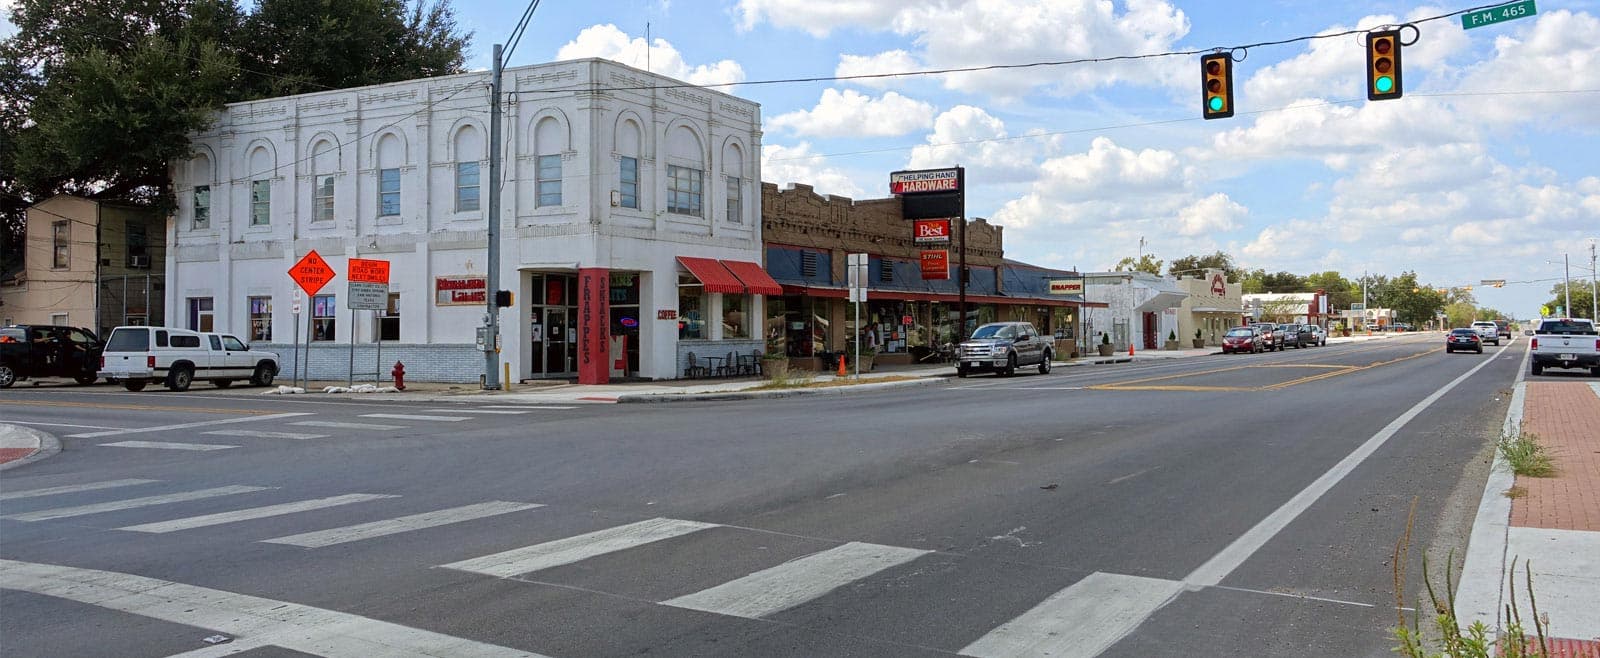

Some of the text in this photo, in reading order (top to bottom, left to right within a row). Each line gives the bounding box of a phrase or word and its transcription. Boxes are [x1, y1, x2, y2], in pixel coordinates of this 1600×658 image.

[1472, 5, 1526, 24] F.M. 465
[903, 171, 956, 181] HELPING HAND
[902, 179, 956, 192] HARDWARE
[919, 224, 943, 237] Best
[300, 266, 325, 275] CENTER
[352, 266, 368, 274] ROAD
[301, 276, 323, 284] STRIPE
[583, 276, 591, 364] FRAPPES
[657, 309, 677, 320] COFFEE
